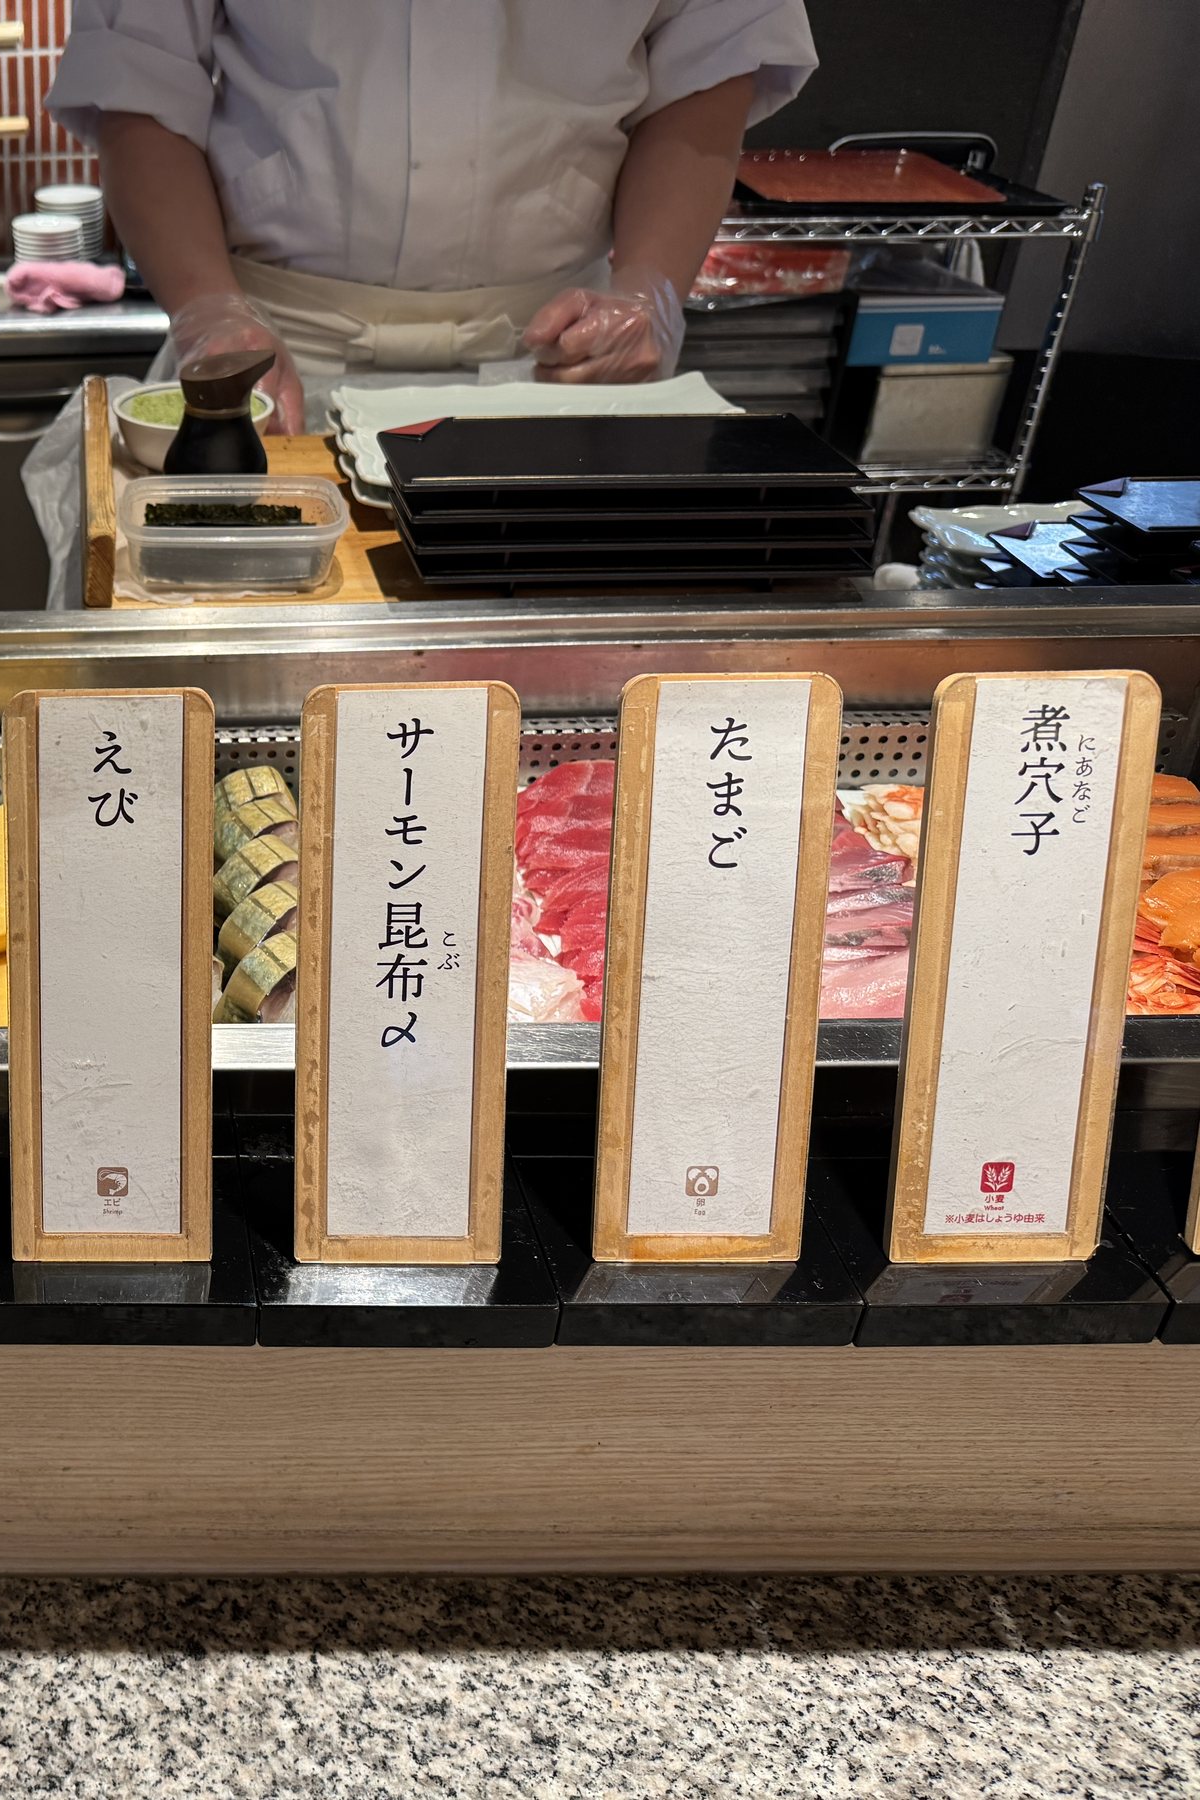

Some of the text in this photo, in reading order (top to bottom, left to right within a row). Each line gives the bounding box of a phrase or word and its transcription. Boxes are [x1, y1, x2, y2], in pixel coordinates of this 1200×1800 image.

[87, 731, 139, 827] えび
[706, 717, 753, 869] たまご
[1011, 704, 1071, 856] 煮穴子
[1071, 733, 1098, 825] にあなご
[375, 717, 435, 1048] サーモン昆布〆
[437, 930, 461, 971] こぶ
[104, 1198, 121, 1206] エビ
[945, 1213, 1045, 1223] ※小麦はしょうゆ由来
[984, 1194, 1004, 1203] 小麦
